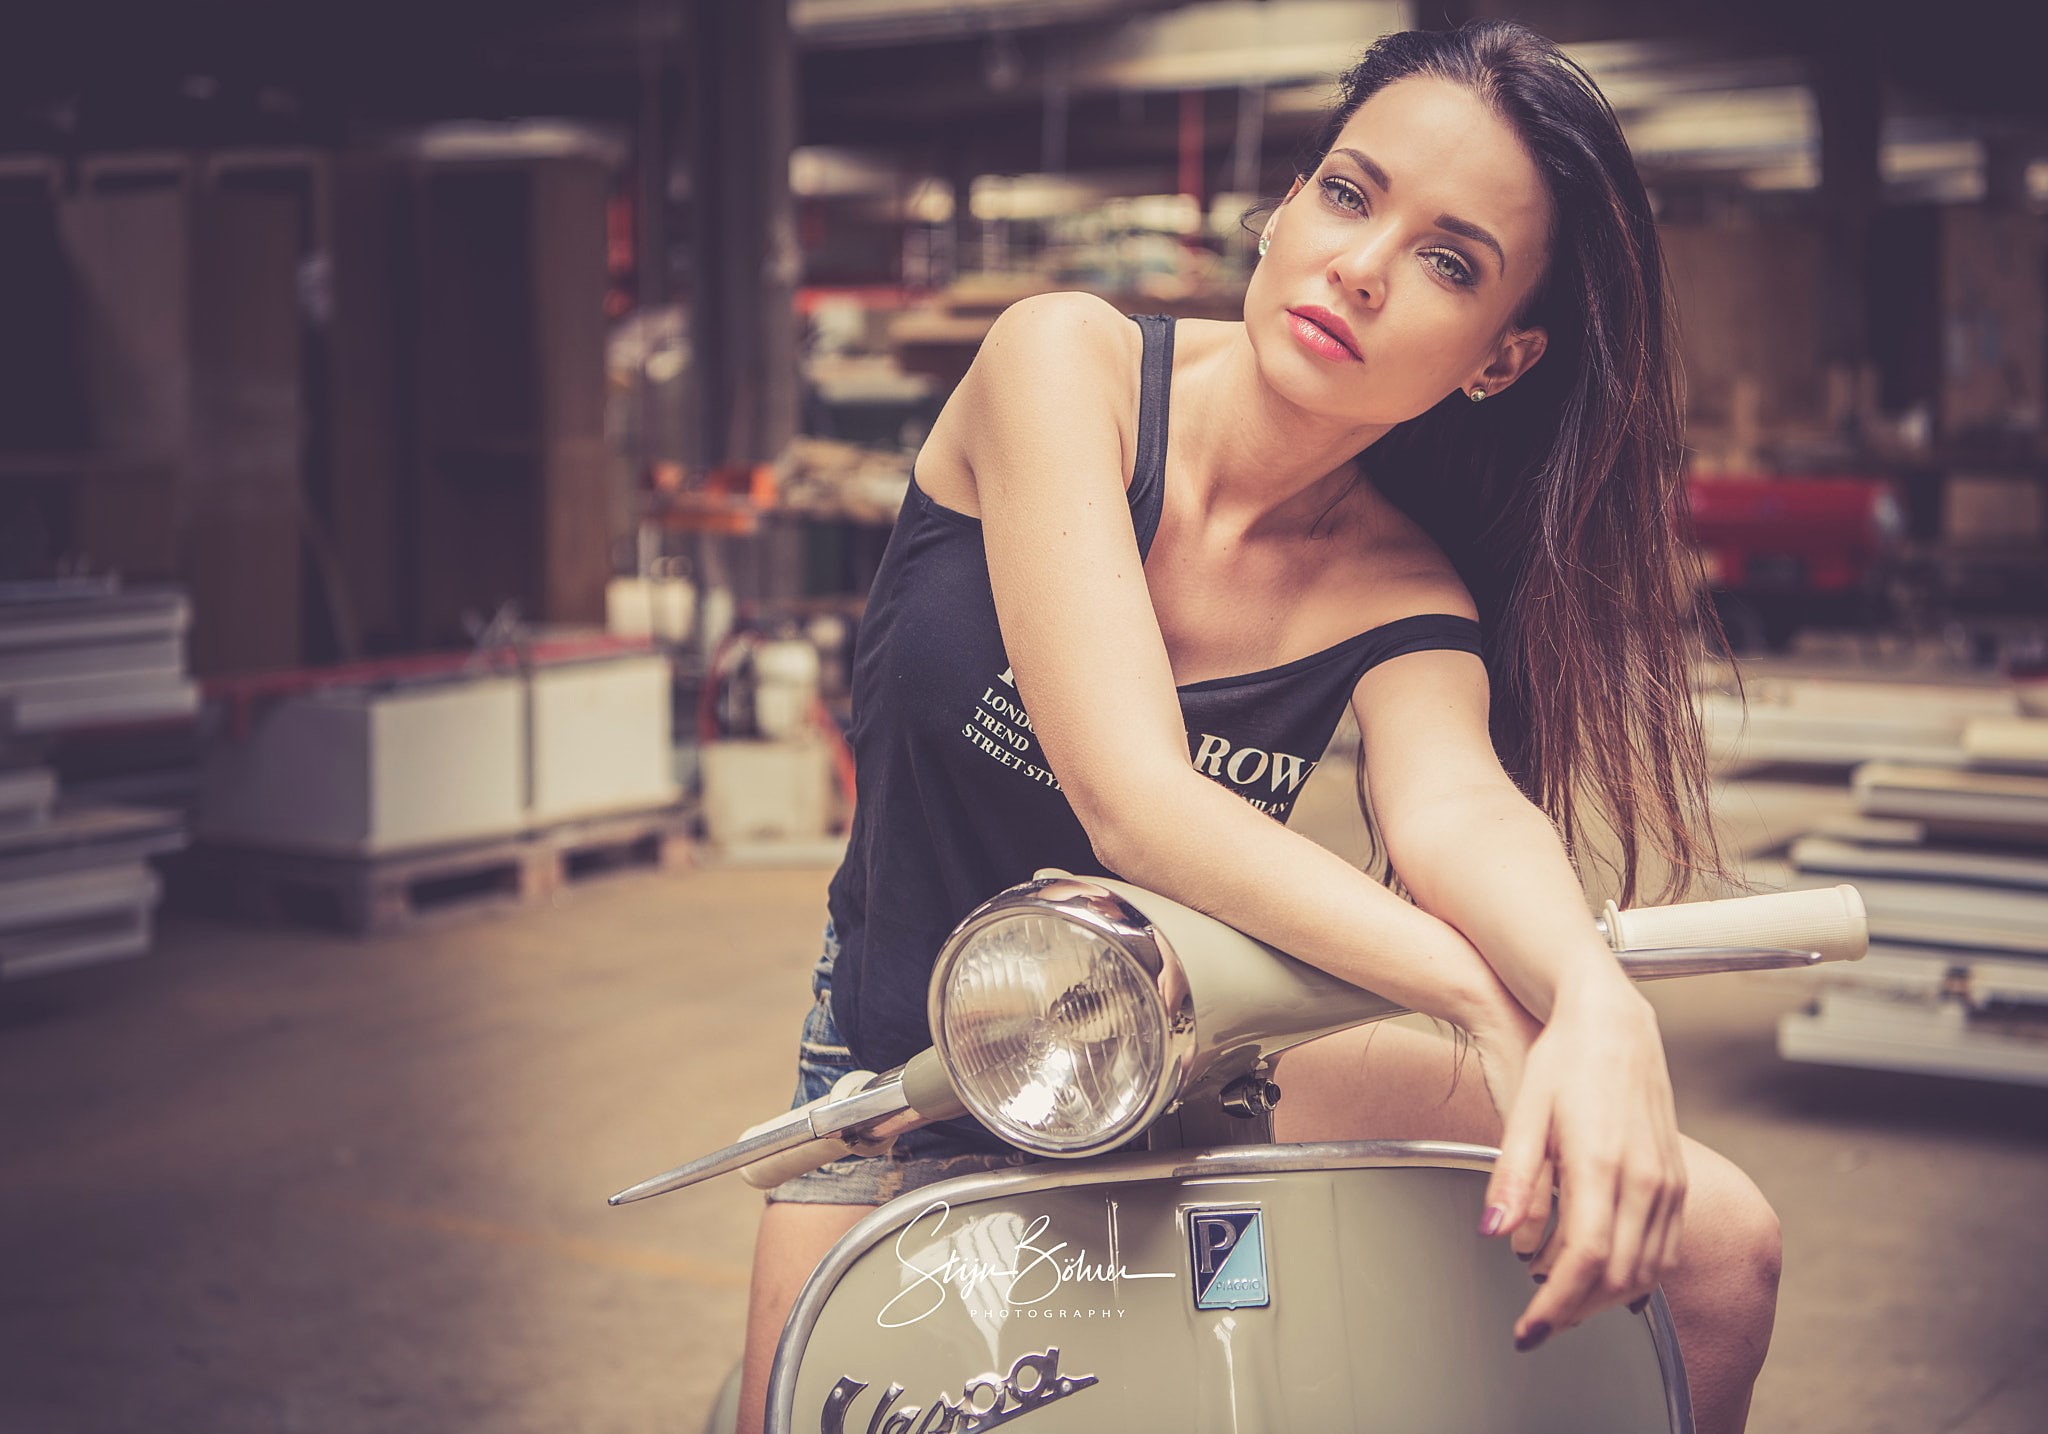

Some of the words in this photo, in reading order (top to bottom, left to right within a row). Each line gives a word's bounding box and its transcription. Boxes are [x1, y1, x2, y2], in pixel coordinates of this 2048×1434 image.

[962, 723, 1026, 770] STREET
[974, 706, 1030, 751] TREND
[1197, 1219, 1237, 1274] P
[1216, 1279, 1261, 1291] PIAGGIO
